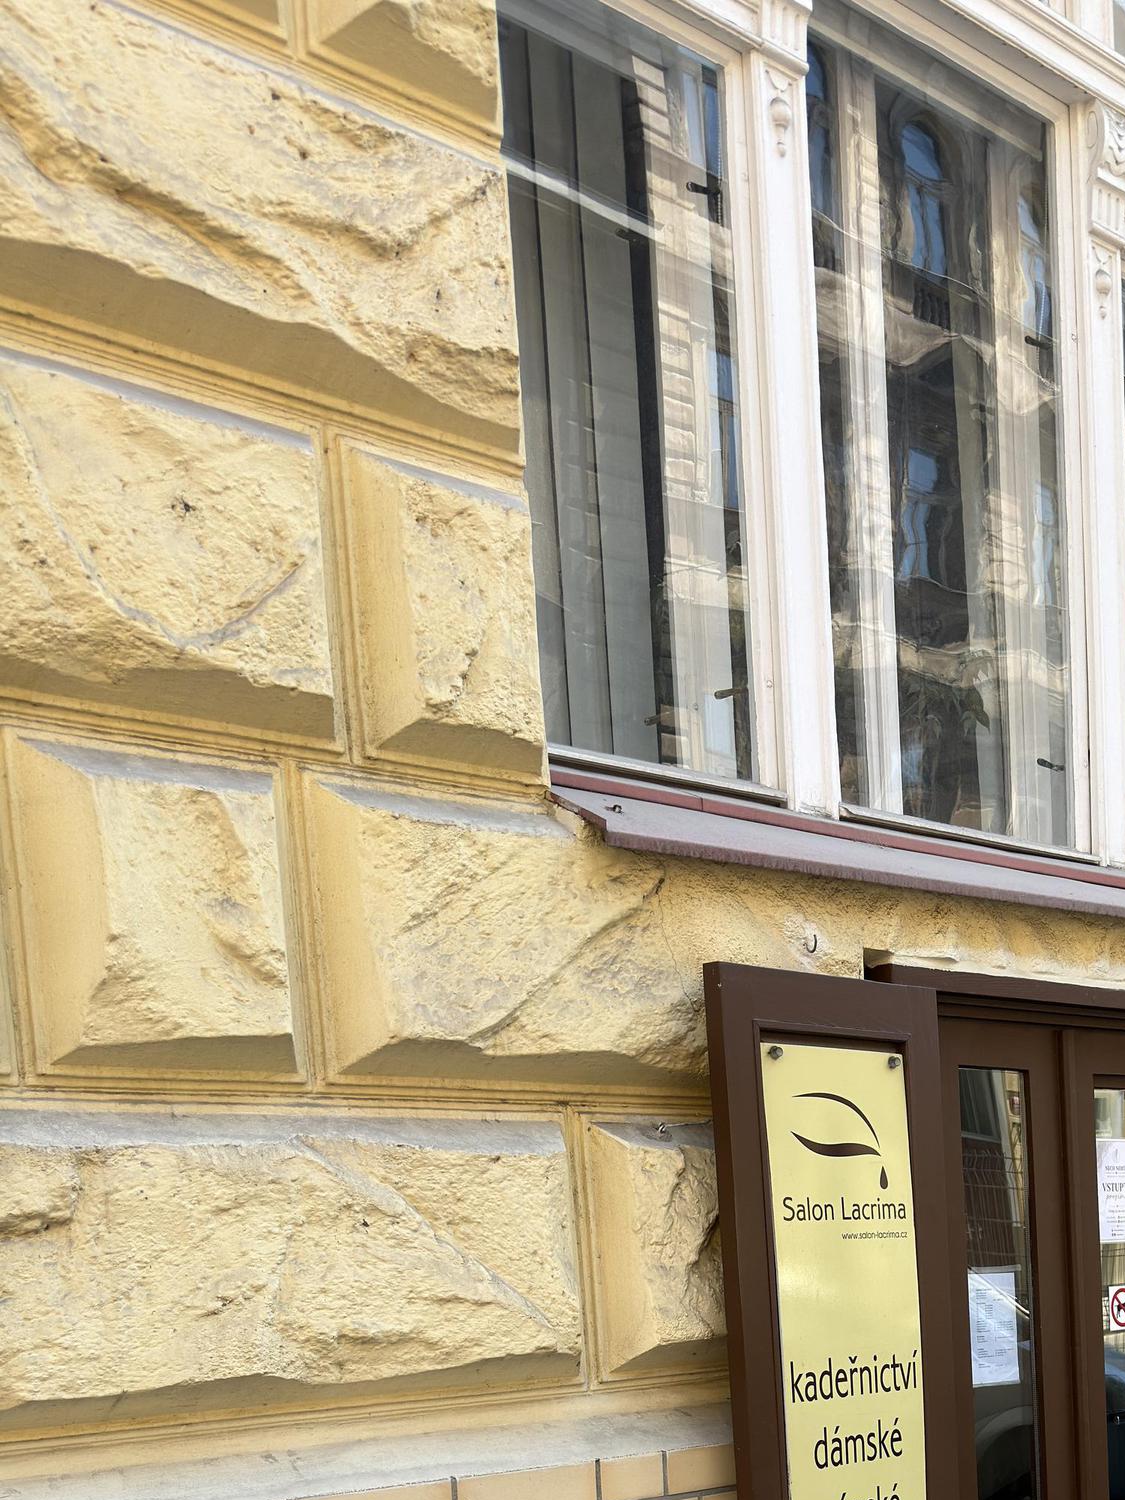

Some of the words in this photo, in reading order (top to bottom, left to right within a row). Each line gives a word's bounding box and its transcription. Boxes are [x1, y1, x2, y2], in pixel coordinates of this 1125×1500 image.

[782, 1196, 835, 1222] Salon
[841, 1196, 907, 1221] Lacrima
[841, 1231, 908, 1240] www.salon-lacrima.cz
[789, 1350, 918, 1404] kadeřnictví
[813, 1417, 904, 1470] dámské
